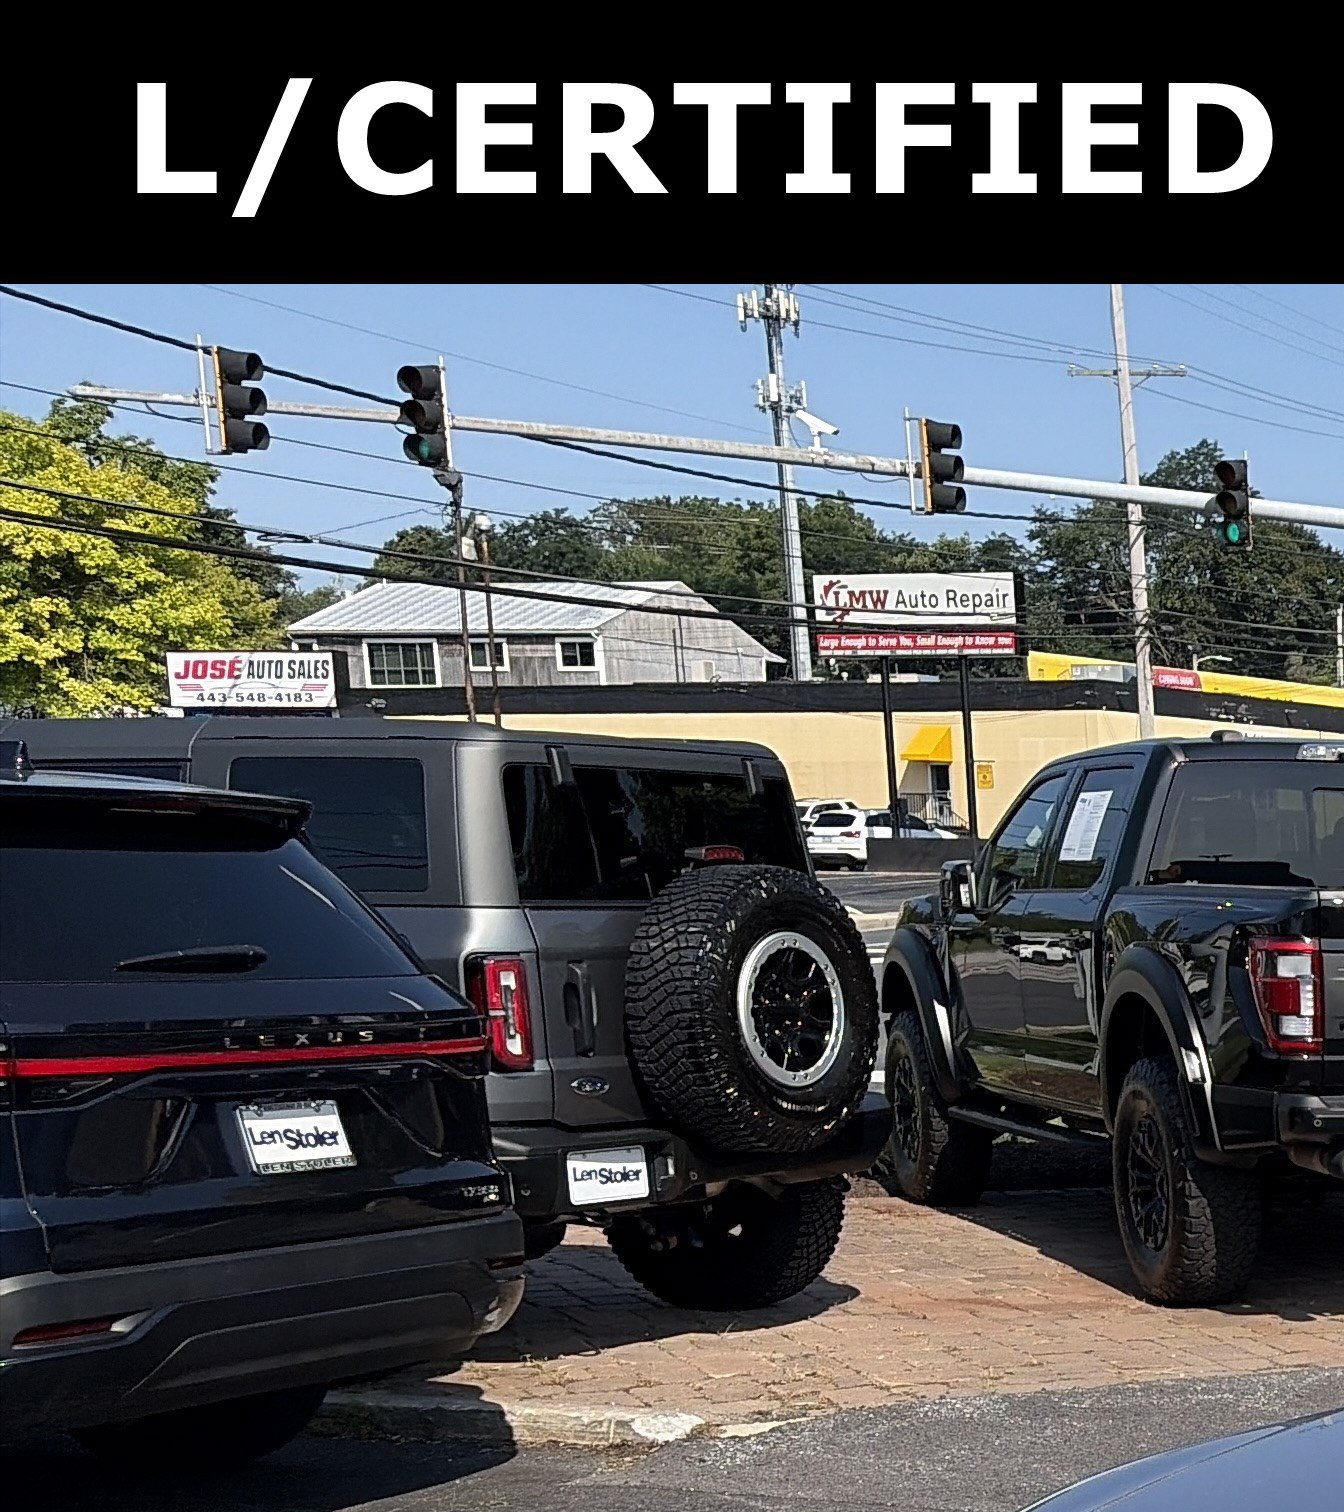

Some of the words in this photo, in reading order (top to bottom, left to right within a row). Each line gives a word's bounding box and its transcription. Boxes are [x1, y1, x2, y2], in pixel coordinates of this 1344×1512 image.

[895, 590, 939, 609] Auto
[945, 588, 1009, 614] Repair
[174, 655, 242, 680] JOSÉ
[247, 660, 284, 680] AUTO
[287, 660, 330, 680] SALES
[196, 692, 314, 703] 443-548-4183
[224, 1030, 374, 1048] LEXUS
